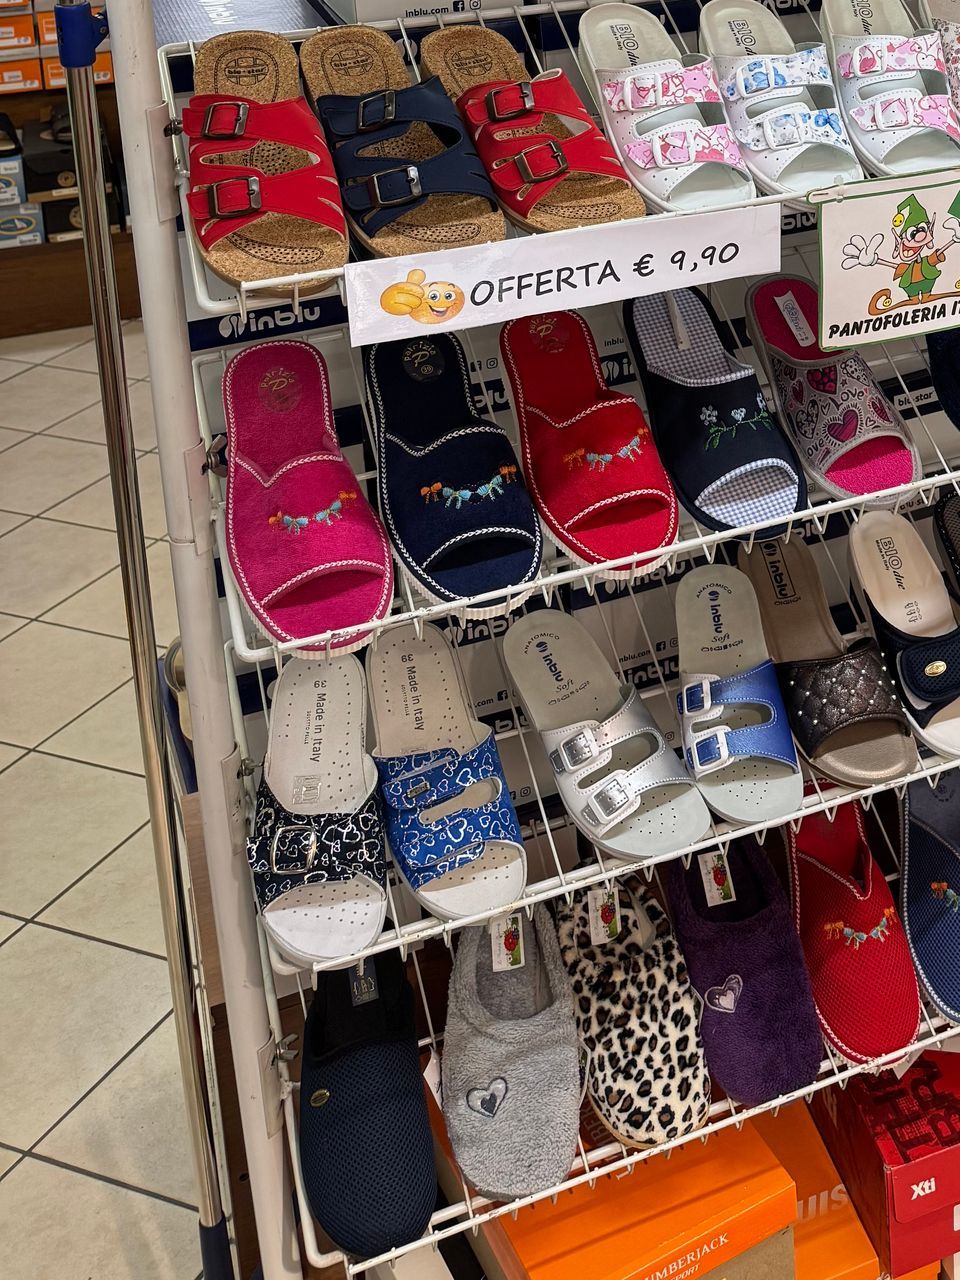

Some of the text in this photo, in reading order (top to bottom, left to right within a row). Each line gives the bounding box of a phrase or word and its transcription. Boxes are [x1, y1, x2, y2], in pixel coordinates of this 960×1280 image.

[405, 5, 449, 17] inblu.com
[616, 24, 639, 50] BIO
[732, 20, 756, 47] BIO
[470, 242, 740, 307] OFFERTA € 9,90
[249, 306, 320, 332] inblu
[828, 303, 947, 339] PANTOFOLERIA
[879, 537, 906, 590] BIO due
[696, 583, 732, 599] ANATOMICO
[768, 559, 790, 599] inblu
[710, 604, 723, 634] inblu
[524, 633, 560, 654] ANATOMICO
[710, 633, 731, 643] Soft
[543, 653, 564, 682] inblu
[406, 666, 425, 731] Made in Italy
[555, 679, 574, 693] Soft
[310, 693, 327, 763] Made in Italy
[911, 1177, 935, 1200] Xti
